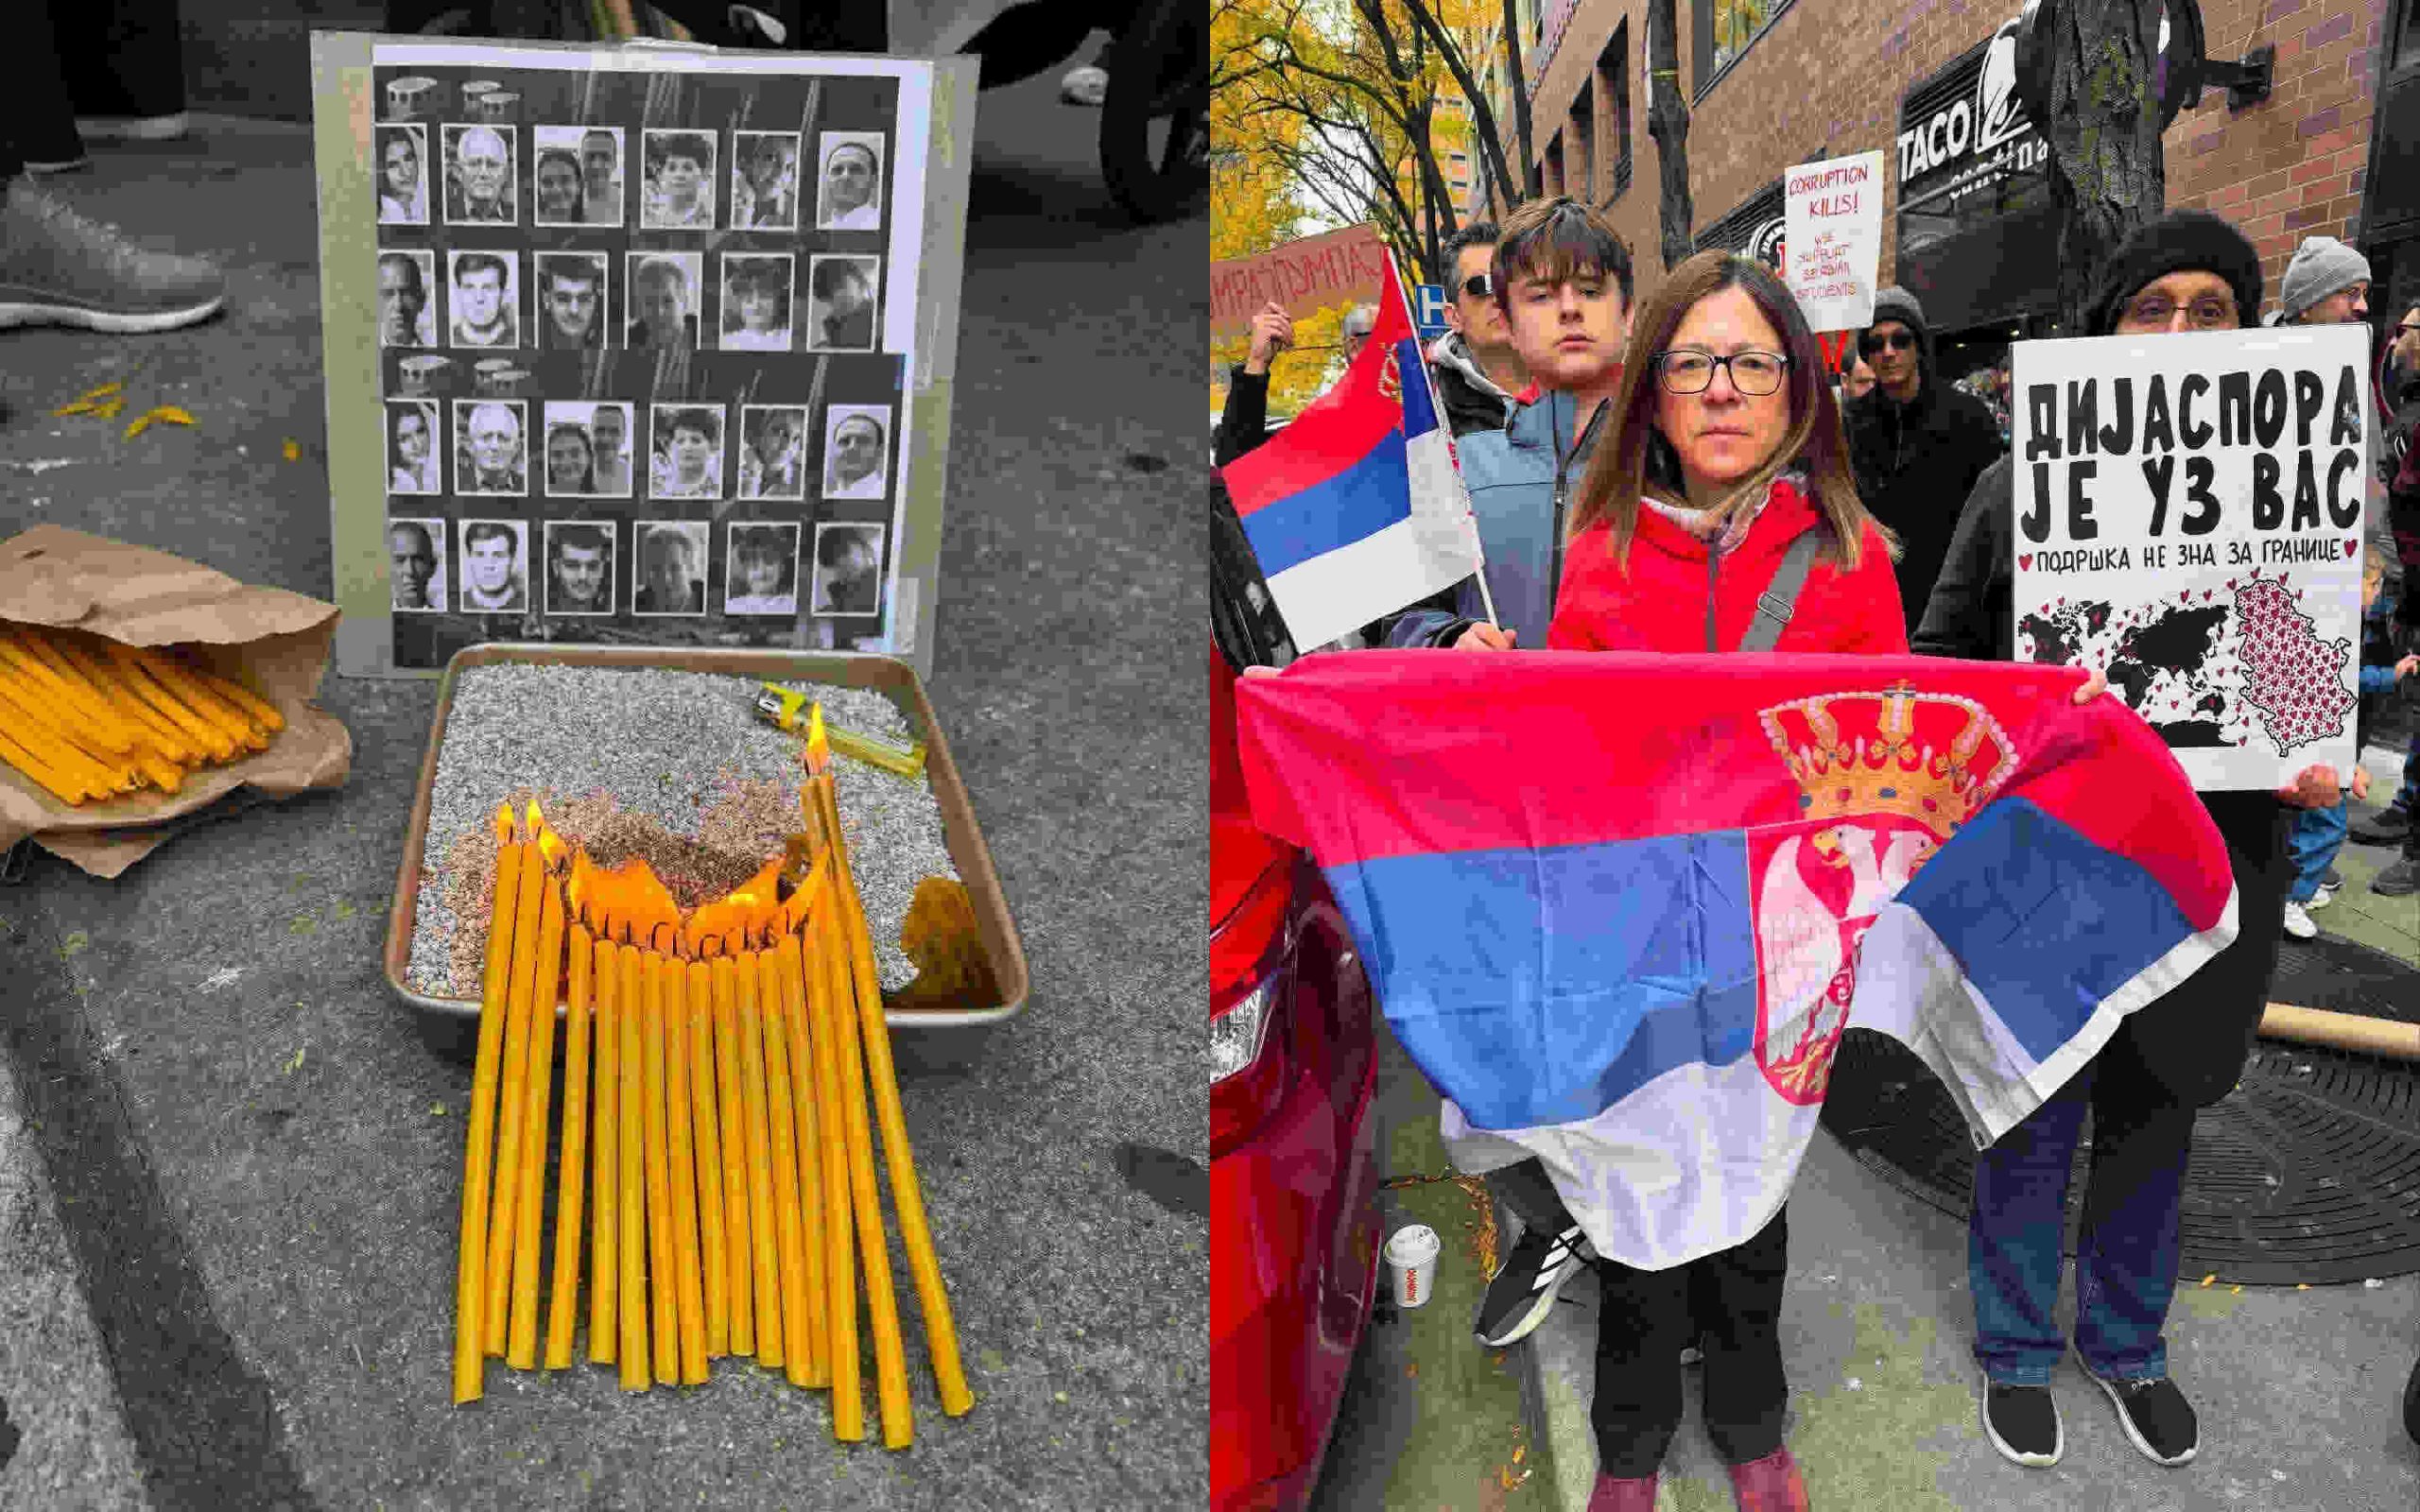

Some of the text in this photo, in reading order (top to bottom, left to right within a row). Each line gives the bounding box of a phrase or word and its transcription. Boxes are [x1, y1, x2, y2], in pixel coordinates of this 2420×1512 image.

[1897, 100, 1971, 181] TACO
[1789, 165, 1869, 196] CORRUPTION
[1809, 192, 1859, 218] KILLS!
[1422, 287, 1448, 324] H
[2026, 365, 2361, 461] ДИЈАСПОРА
[2020, 448, 2360, 543] ЈЕ УЗ ВАС
[2036, 538, 2341, 574] ПОДРШКА НЕ ЗНА ЗА ГРАНИЦЕ
